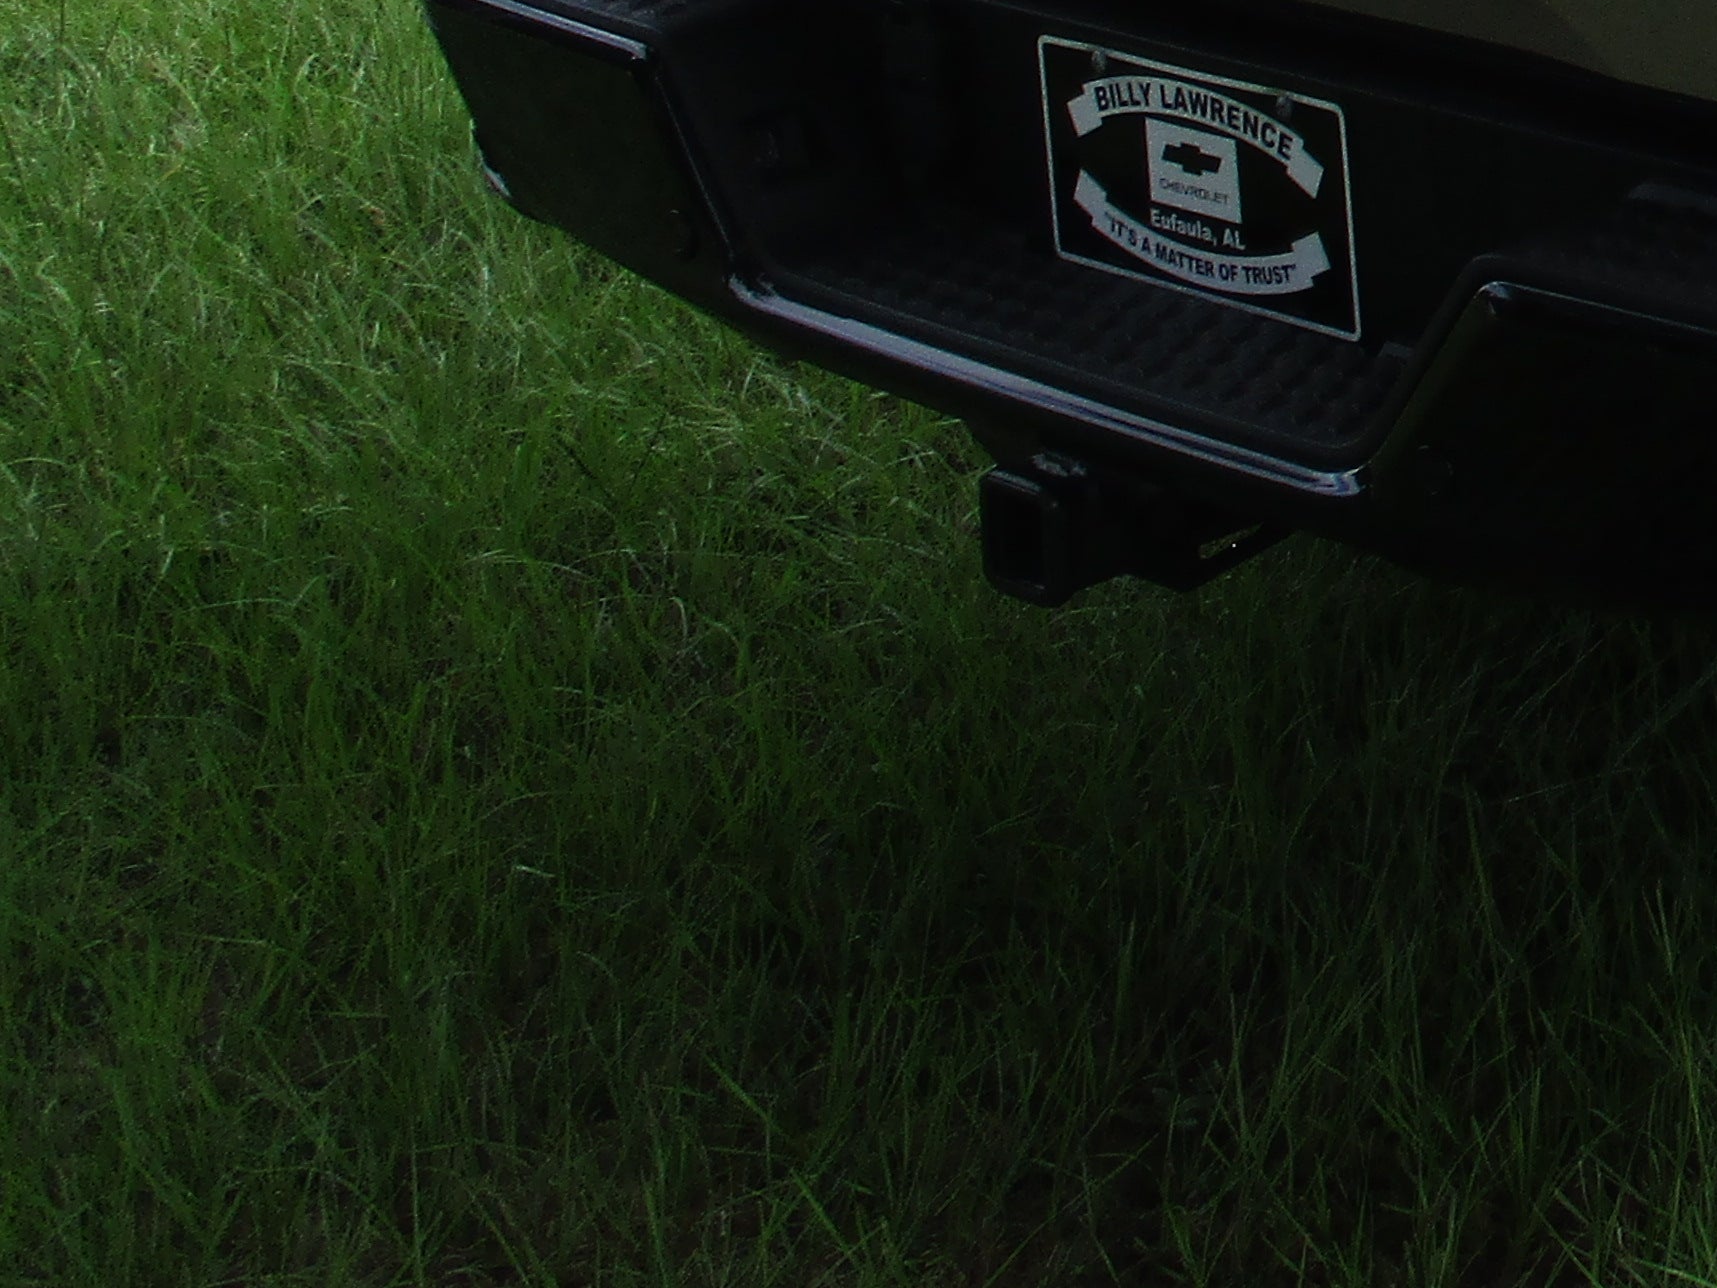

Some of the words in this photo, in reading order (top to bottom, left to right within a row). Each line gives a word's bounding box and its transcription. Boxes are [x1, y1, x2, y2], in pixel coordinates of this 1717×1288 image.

[1093, 81, 1151, 113] BILLY
[1159, 84, 1294, 162] LAWRENCE
[1159, 177, 1230, 206] CHEVROLET
[1150, 208, 1218, 247] Eufaula,
[1221, 228, 1246, 251] AL
[1142, 236, 1151, 255] A
[1155, 242, 1215, 276] MATTER
[1218, 265, 1239, 281] OF
